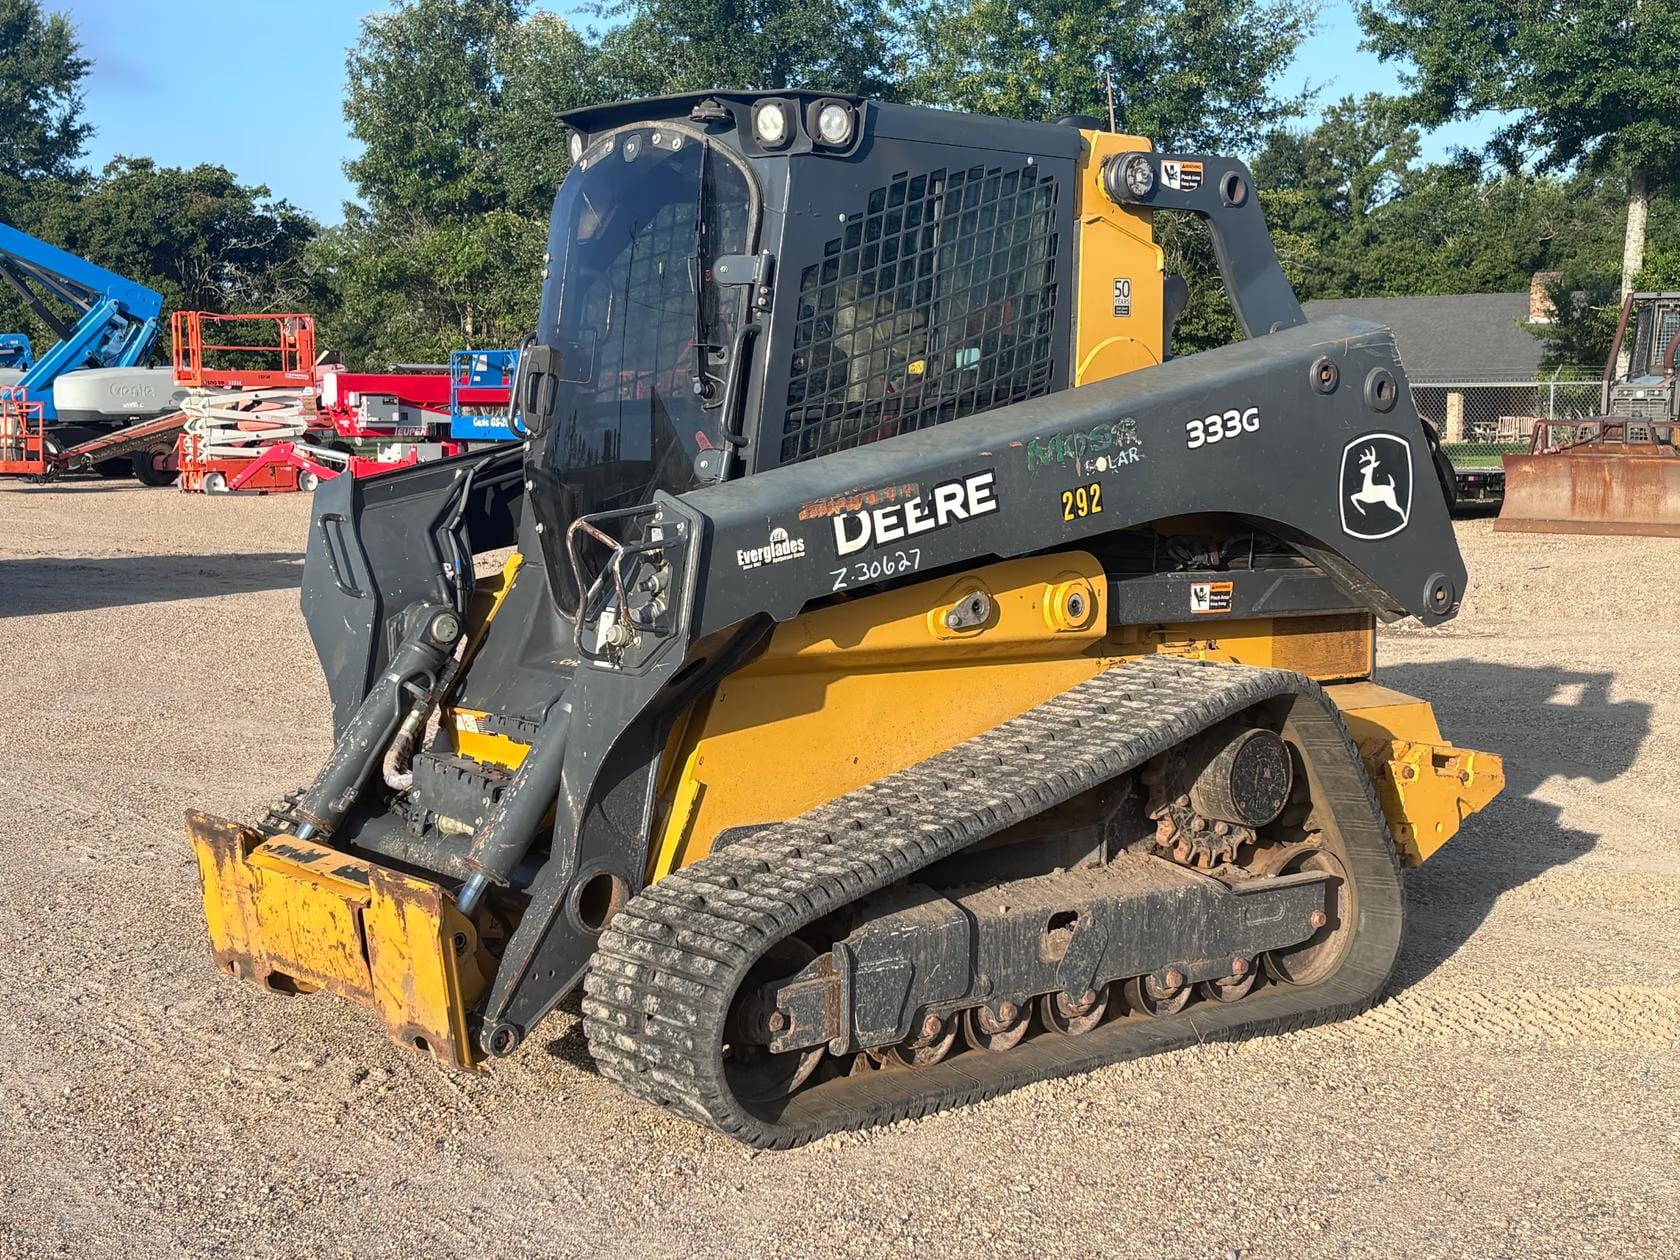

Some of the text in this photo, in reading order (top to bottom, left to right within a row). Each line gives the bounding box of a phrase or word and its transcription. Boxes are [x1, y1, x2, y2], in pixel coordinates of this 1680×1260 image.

[1114, 280, 1130, 298] 50
[1185, 407, 1261, 450] 333G
[832, 472, 997, 556] DEERE
[1061, 482, 1103, 522] 292
[736, 537, 806, 566] Everglades
